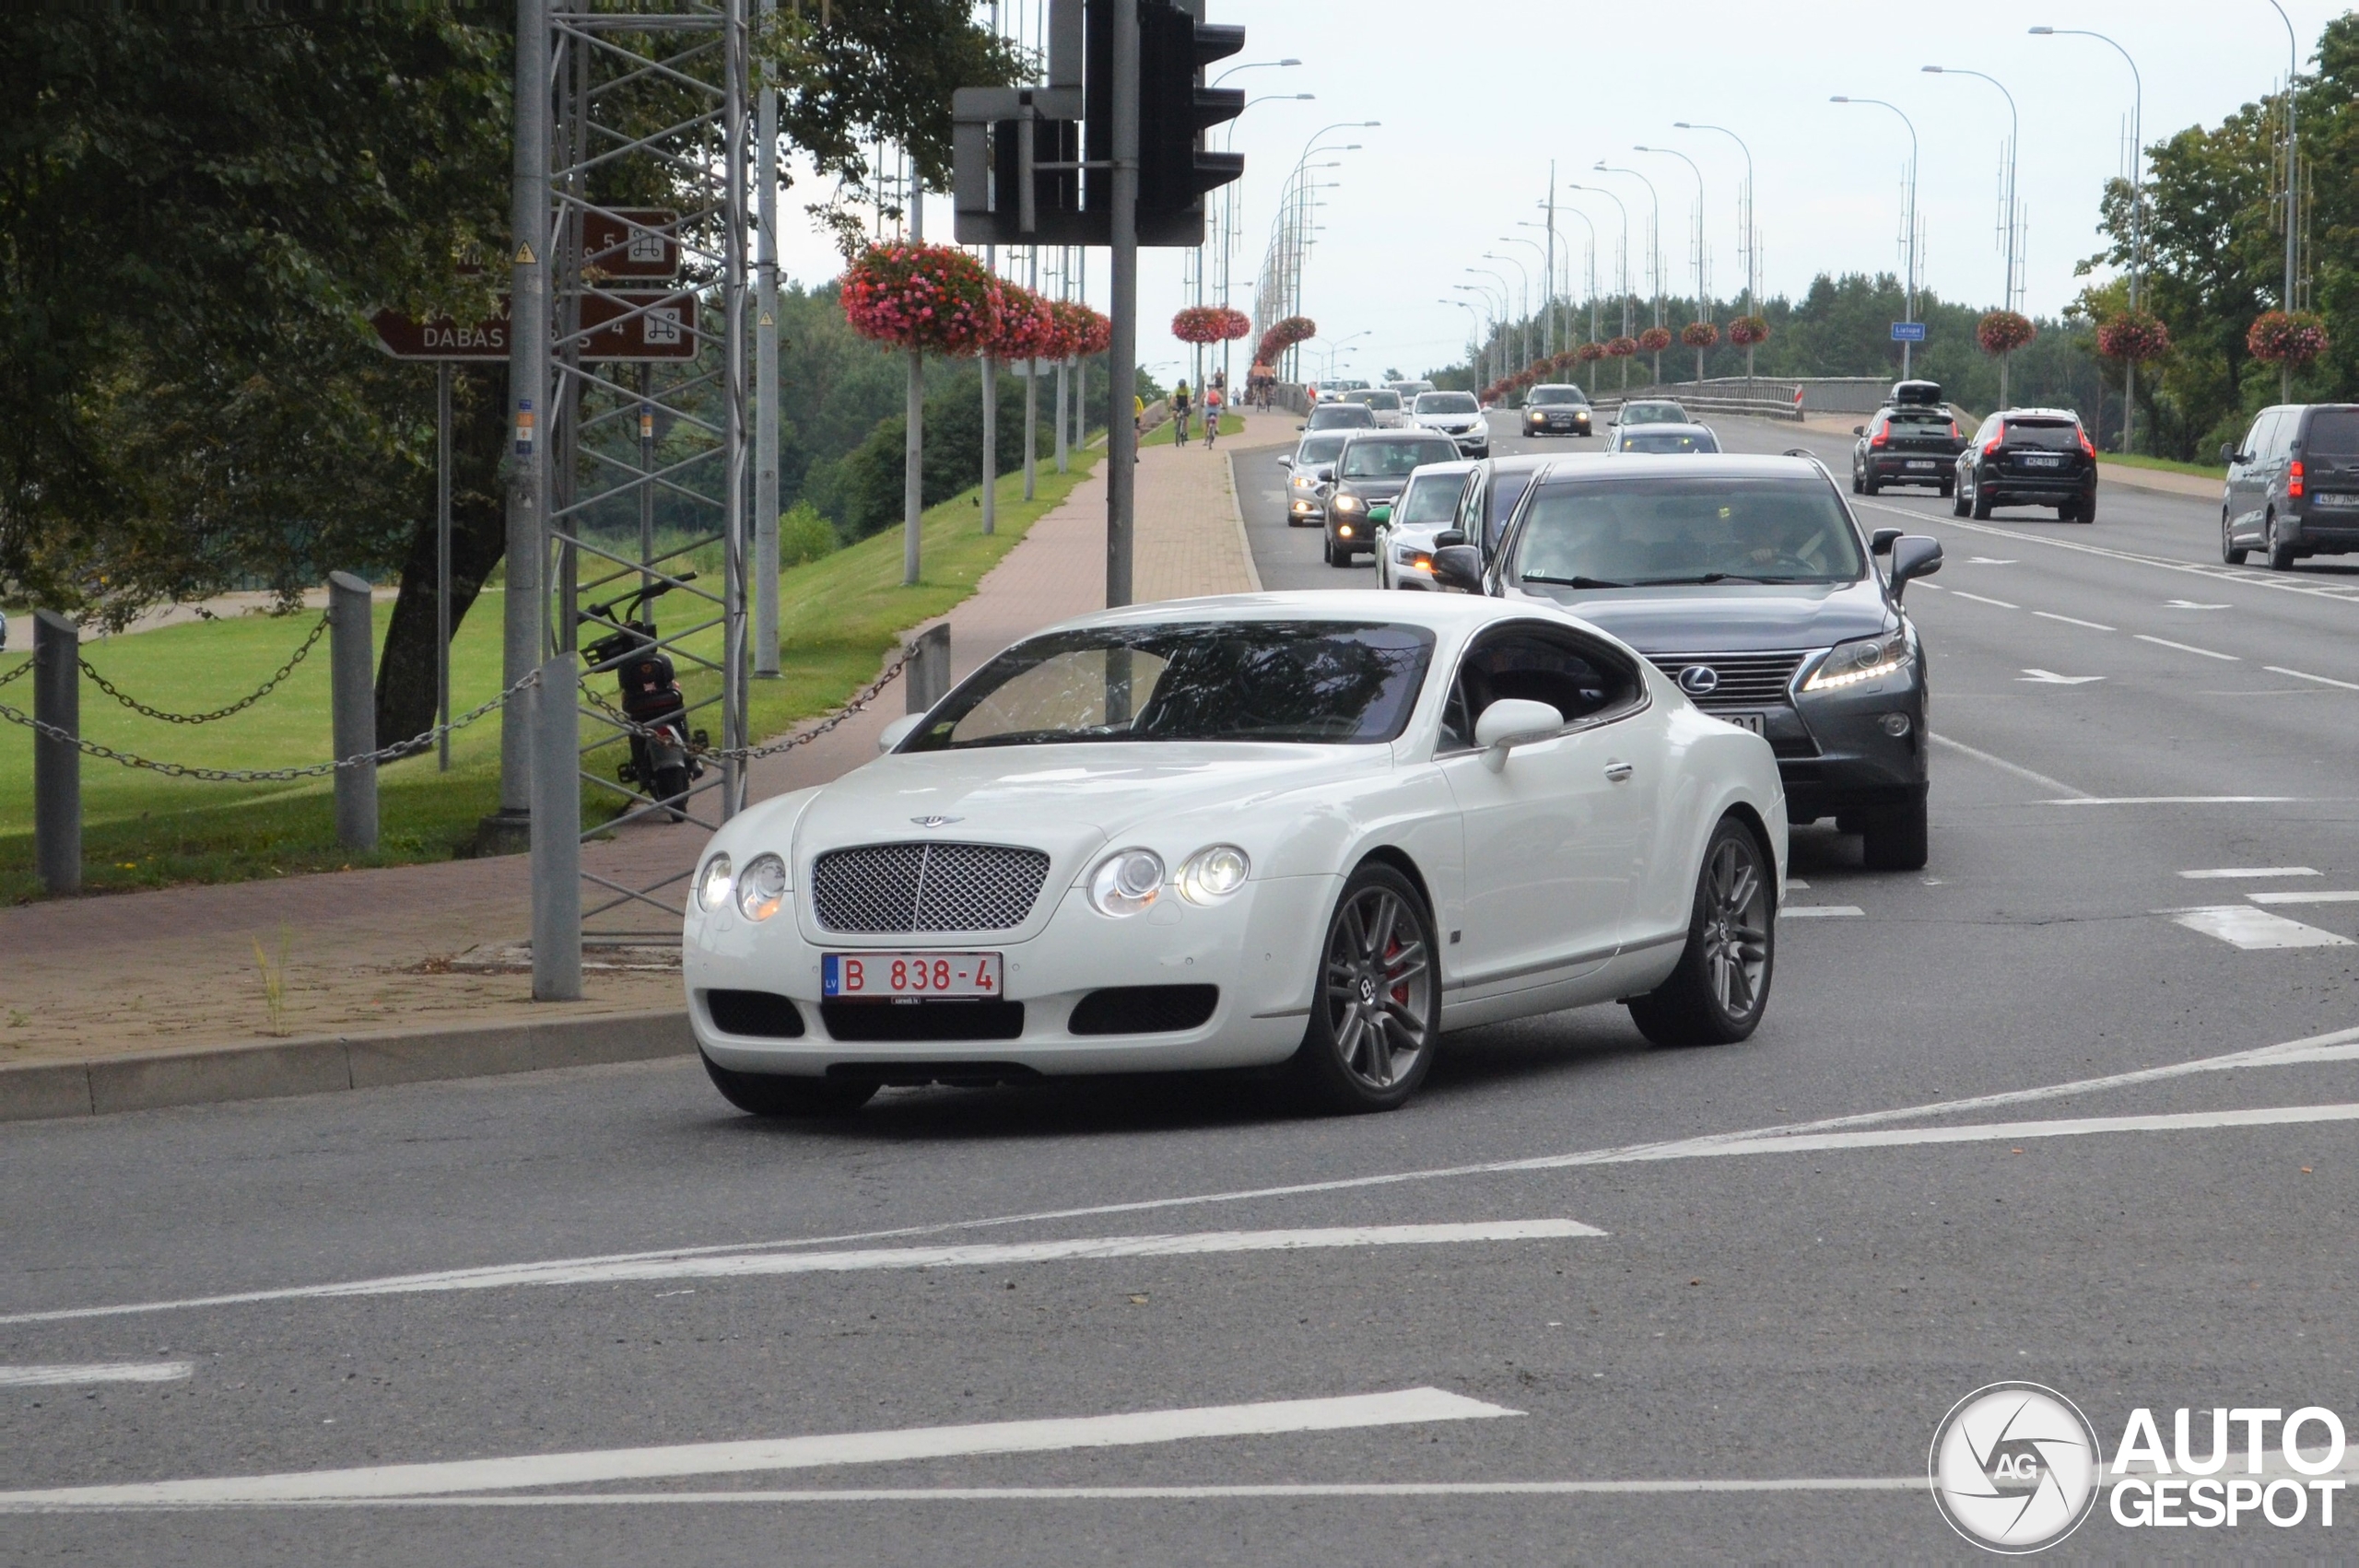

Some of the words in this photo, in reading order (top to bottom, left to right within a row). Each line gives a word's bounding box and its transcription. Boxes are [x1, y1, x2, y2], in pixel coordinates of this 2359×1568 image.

[603, 233, 616, 250] 5
[423, 328, 504, 347] DABAS
[611, 322, 625, 335] 4
[826, 979, 838, 989] LV
[845, 960, 864, 990] B
[890, 959, 993, 990] 838-4
